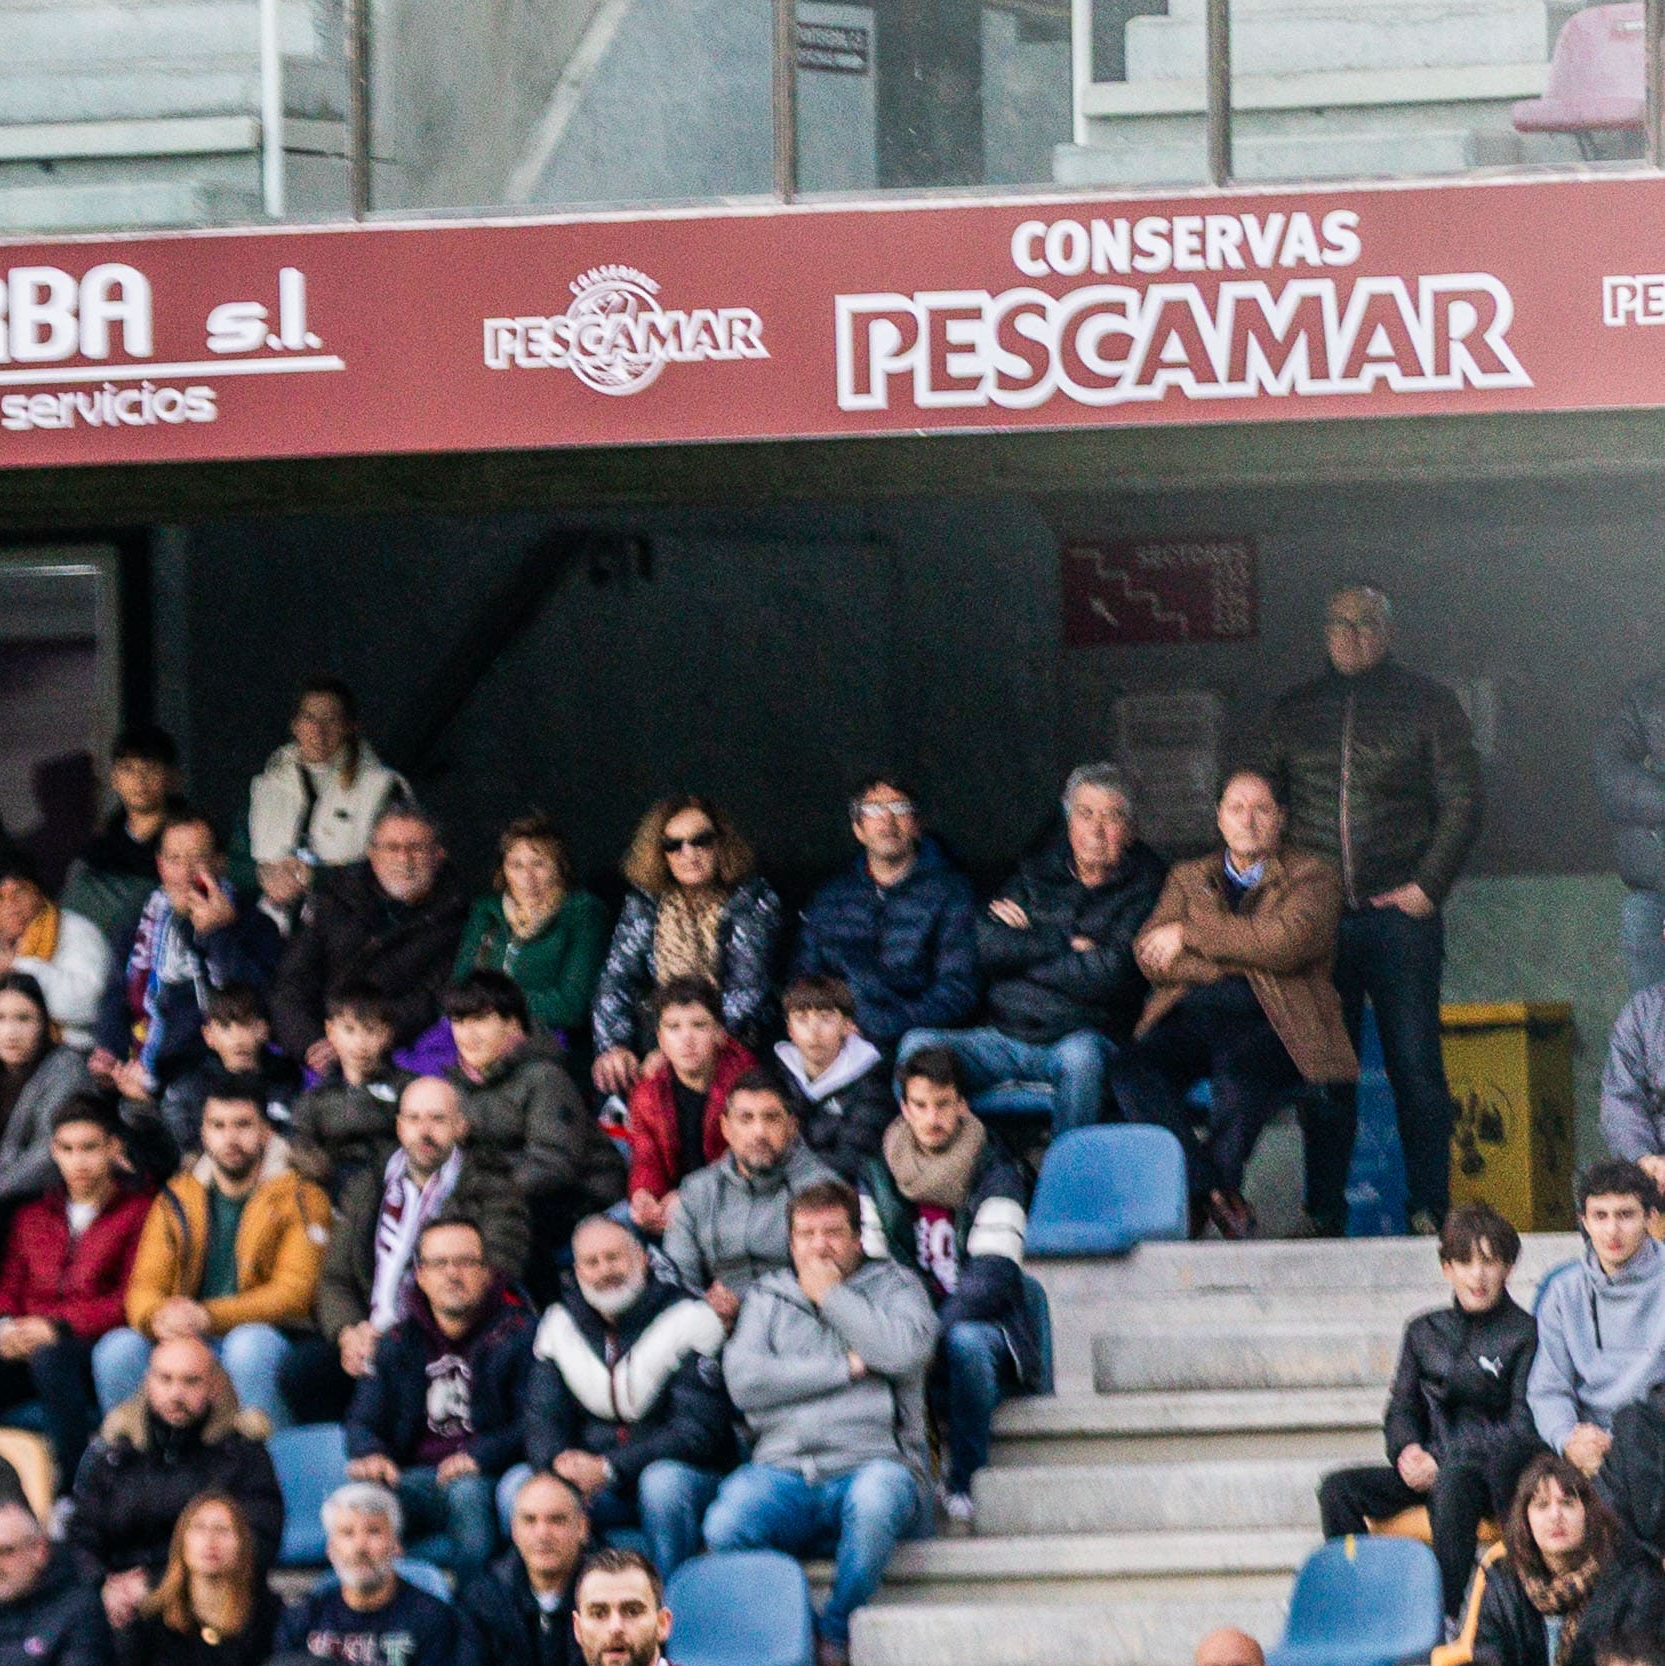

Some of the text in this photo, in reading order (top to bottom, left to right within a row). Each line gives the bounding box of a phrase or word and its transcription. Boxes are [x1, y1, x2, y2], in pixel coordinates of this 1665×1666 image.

[1011, 210, 1362, 277] CONSERVAS
[483, 307, 772, 370] PESCAMAR
[836, 272, 1536, 410] PESCAMAR
[1, 382, 219, 431] servicios
